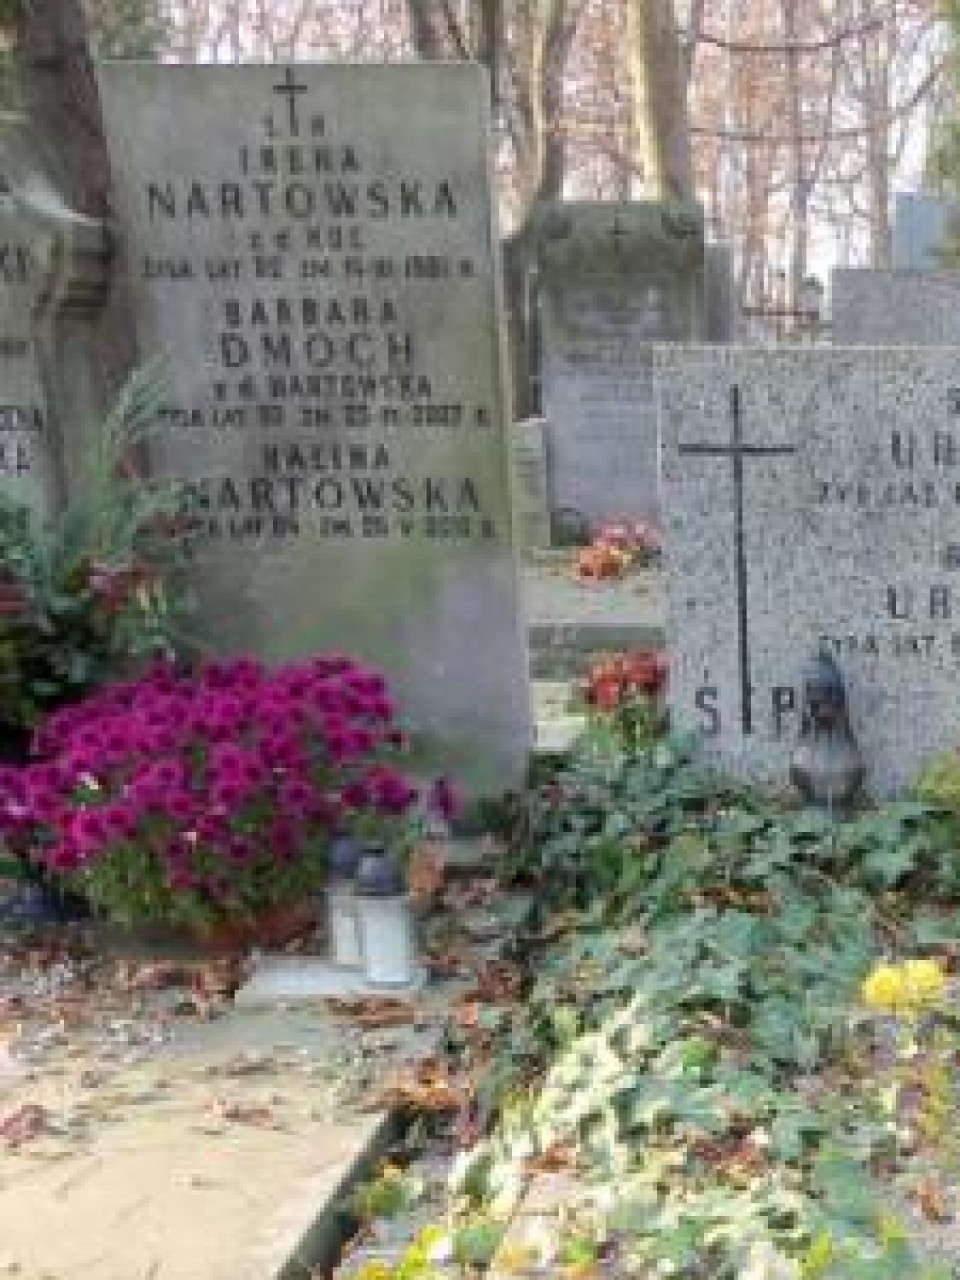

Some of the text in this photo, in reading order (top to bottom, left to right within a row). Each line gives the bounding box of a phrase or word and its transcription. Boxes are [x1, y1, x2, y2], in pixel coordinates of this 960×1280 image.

[239, 146, 362, 174] IRENA
[146, 180, 459, 220] NARTOWSKA
[223, 299, 398, 327] BARBARA
[219, 332, 415, 369] DMOCH
[262, 444, 390, 473] HALINA
